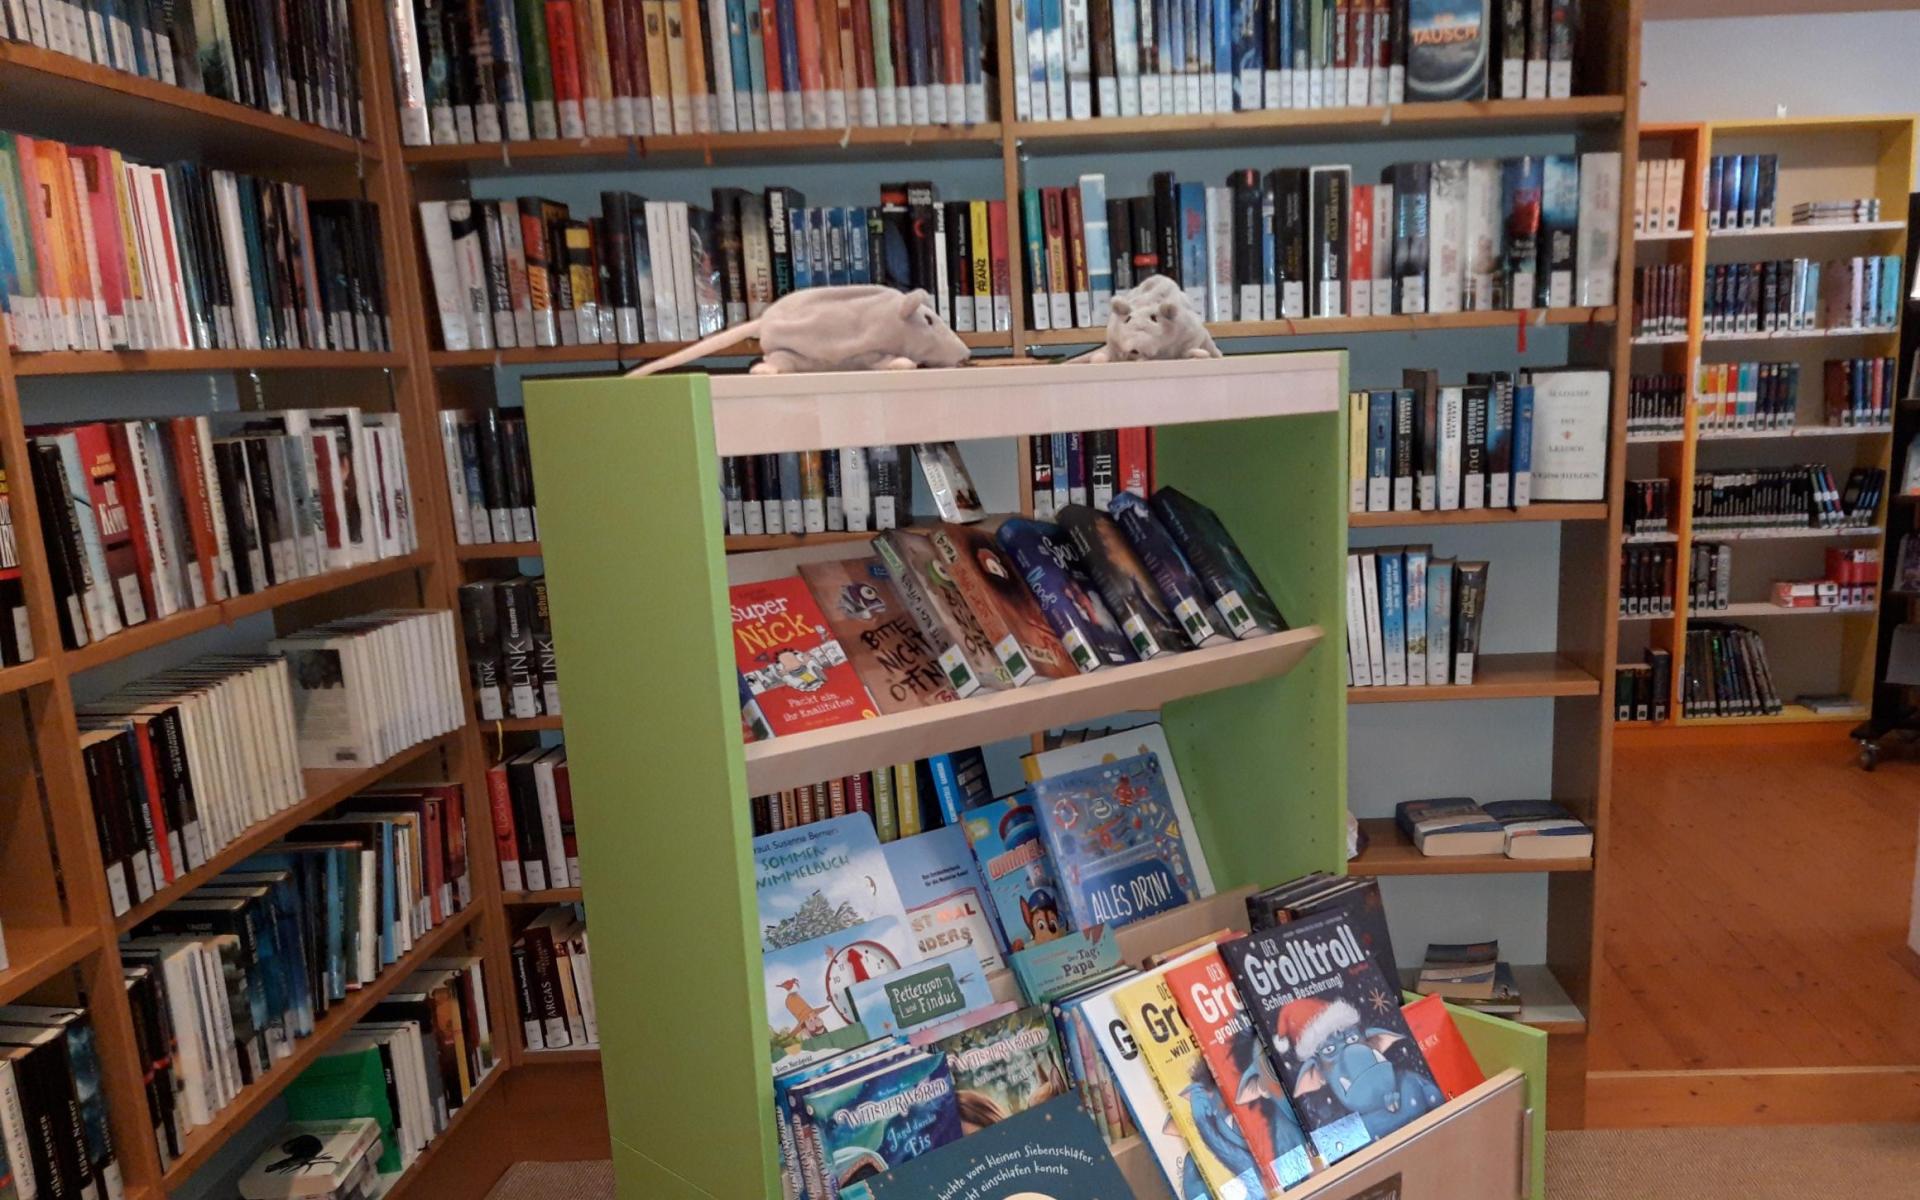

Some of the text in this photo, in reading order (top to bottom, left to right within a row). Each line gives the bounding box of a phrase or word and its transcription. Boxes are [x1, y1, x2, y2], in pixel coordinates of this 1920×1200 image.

[1411, 25, 1478, 46] TAUSCH
[975, 257, 987, 293] FRANZ
[1093, 453, 1112, 490] Hill
[731, 598, 788, 623] Super
[736, 612, 815, 654] Nick
[482, 660, 499, 690] INK
[511, 639, 532, 687] LINK
[542, 639, 559, 686] LINK
[772, 835, 807, 850] Susanne
[762, 846, 828, 871] SOMMER-
[1091, 871, 1174, 923] ALLES DRIN!
[1078, 946, 1101, 960] Tag,
[1244, 924, 1366, 996] Grolltroll
[1260, 938, 1279, 957] DER
[1062, 959, 1095, 977] Papa
[1205, 962, 1225, 982] DER
[542, 981, 558, 1017] ARGAS
[891, 976, 943, 1003] Pettersson
[919, 991, 957, 1014] Findus
[1262, 973, 1344, 1011] Schöne Bescherung!
[835, 1078, 949, 1128] WHISPERWORLD
[905, 1134, 932, 1156] Eis
[967, 1163, 986, 1180] vom
[985, 1150, 1021, 1168] kleinen
[1024, 1142, 1095, 1166] Siebenschläfer,
[980, 1166, 1031, 1192] einschlafen
[1034, 1160, 1069, 1176] konnte
